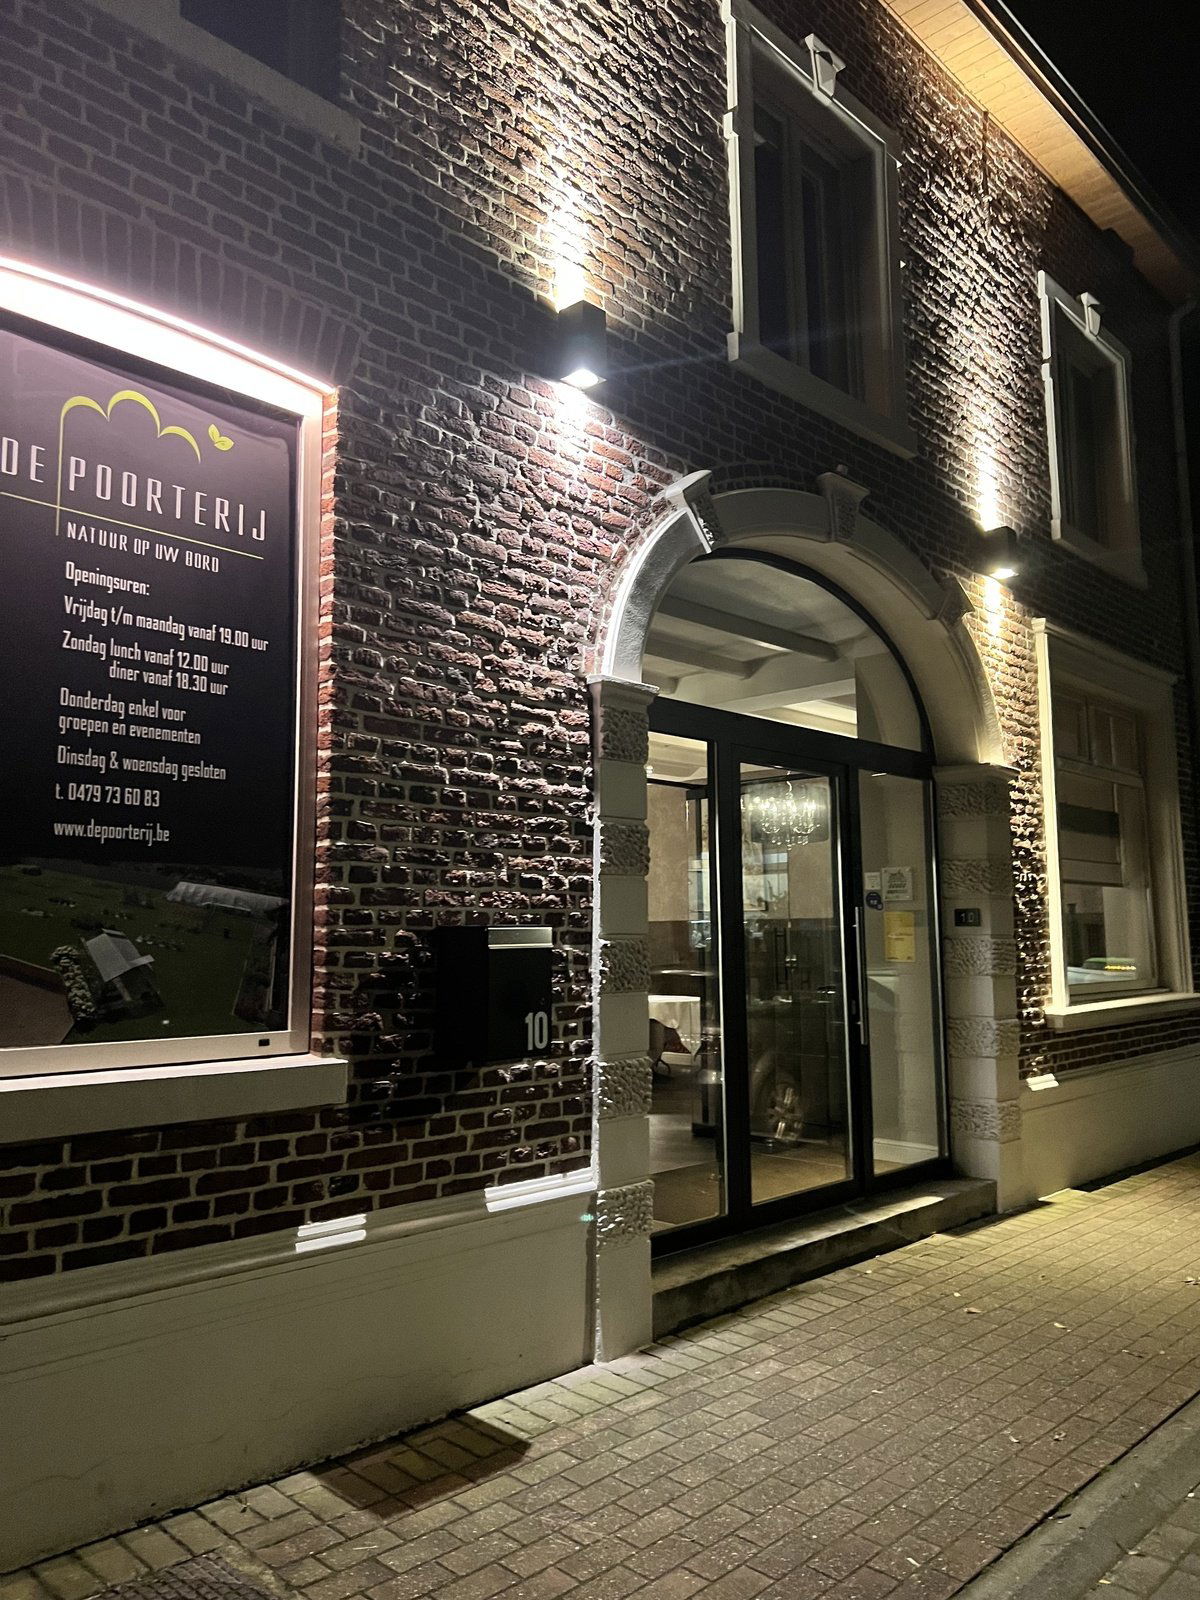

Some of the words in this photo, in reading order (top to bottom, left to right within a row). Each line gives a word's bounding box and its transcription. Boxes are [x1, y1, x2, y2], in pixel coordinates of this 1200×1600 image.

[1, 437, 46, 483] DE
[68, 456, 266, 541] POORTERIJ
[68, 522, 128, 552] NATUUR
[134, 538, 150, 555] OP
[156, 544, 179, 563] UW
[186, 551, 219, 573] BORD
[65, 561, 150, 596] Openingsuren:
[64, 596, 108, 626] Vrijdag
[111, 606, 133, 626] t/m
[136, 616, 185, 641] maandag
[188, 625, 217, 641] vanaf
[219, 627, 249, 647] 19.00
[252, 638, 268, 651] uur
[62, 630, 106, 660] Zondag
[110, 639, 141, 660] lunch
[144, 649, 174, 665] vanaf
[177, 652, 208, 672] 12.00
[211, 661, 229, 675] uur
[109, 661, 140, 681] diner
[143, 670, 173, 687] vanaf
[176, 672, 207, 693] 18.30
[210, 682, 228, 695] uur
[60, 688, 125, 719] Donderdag
[128, 701, 159, 718] enkel
[162, 708, 186, 722] voor
[59, 716, 108, 737] groepen
[112, 723, 126, 736] en
[129, 725, 201, 745] evenementen
[57, 746, 105, 774] Dinsdag
[110, 752, 119, 769] &
[123, 757, 178, 780] woensdag
[181, 761, 226, 781] gesloten
[55, 784, 64, 800] t.
[68, 783, 101, 802] 0479
[105, 786, 120, 804] 73
[124, 788, 140, 805] 60
[144, 790, 160, 807] 83
[54, 819, 170, 846] www.depoorterij.be
[524, 1012, 548, 1050] 10
